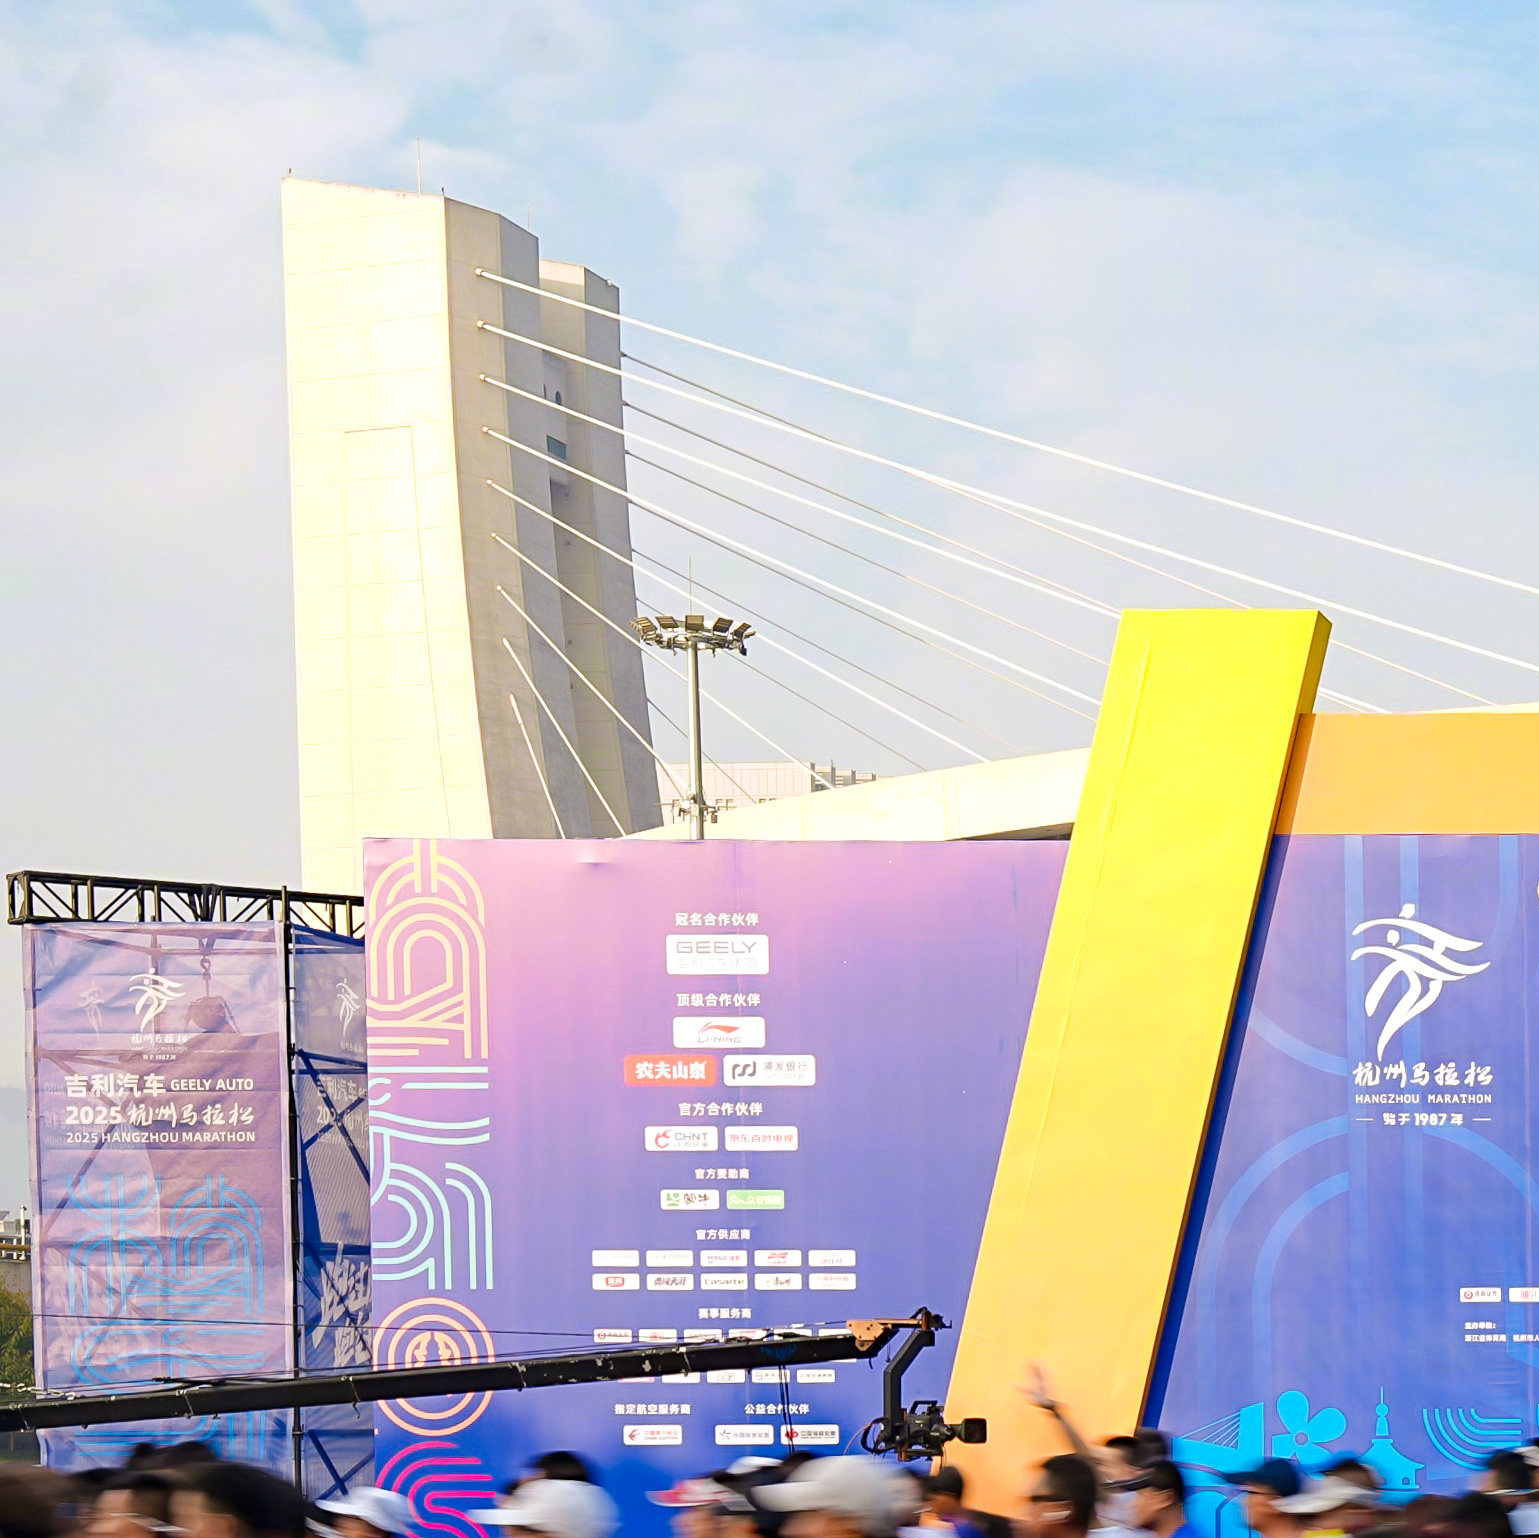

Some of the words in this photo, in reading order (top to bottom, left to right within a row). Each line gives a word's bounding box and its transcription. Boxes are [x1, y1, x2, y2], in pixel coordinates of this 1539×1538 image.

[675, 913, 759, 926] 冠名合作伙伴
[676, 941, 757, 953] GEELY
[677, 993, 760, 1006] 顶级合作伙伴
[635, 1061, 706, 1080] 农夫山泉
[763, 1061, 807, 1072] 浦发银行
[1352, 1060, 1493, 1088] 杭州马拉松
[65, 1072, 166, 1097] 吉利汽车
[171, 1079, 211, 1091] GEELY
[216, 1079, 254, 1091] AUTO
[1356, 1094, 1419, 1103] HANGZHOU
[1428, 1094, 1491, 1103] MARATHON
[65, 1105, 122, 1125] 2025
[126, 1101, 254, 1128] 杭州马拉松
[679, 1102, 763, 1116] 官方合作伙伴
[66, 1132, 98, 1143] 2025
[101, 1132, 178, 1143] HANGZHOU
[182, 1131, 255, 1142] MARATHON
[695, 1169, 749, 1179] 官方赞助商
[696, 1229, 750, 1240] 官方供应商
[699, 1308, 751, 1318] 赛事服务商
[615, 1404, 690, 1414] 指定航空服务商
